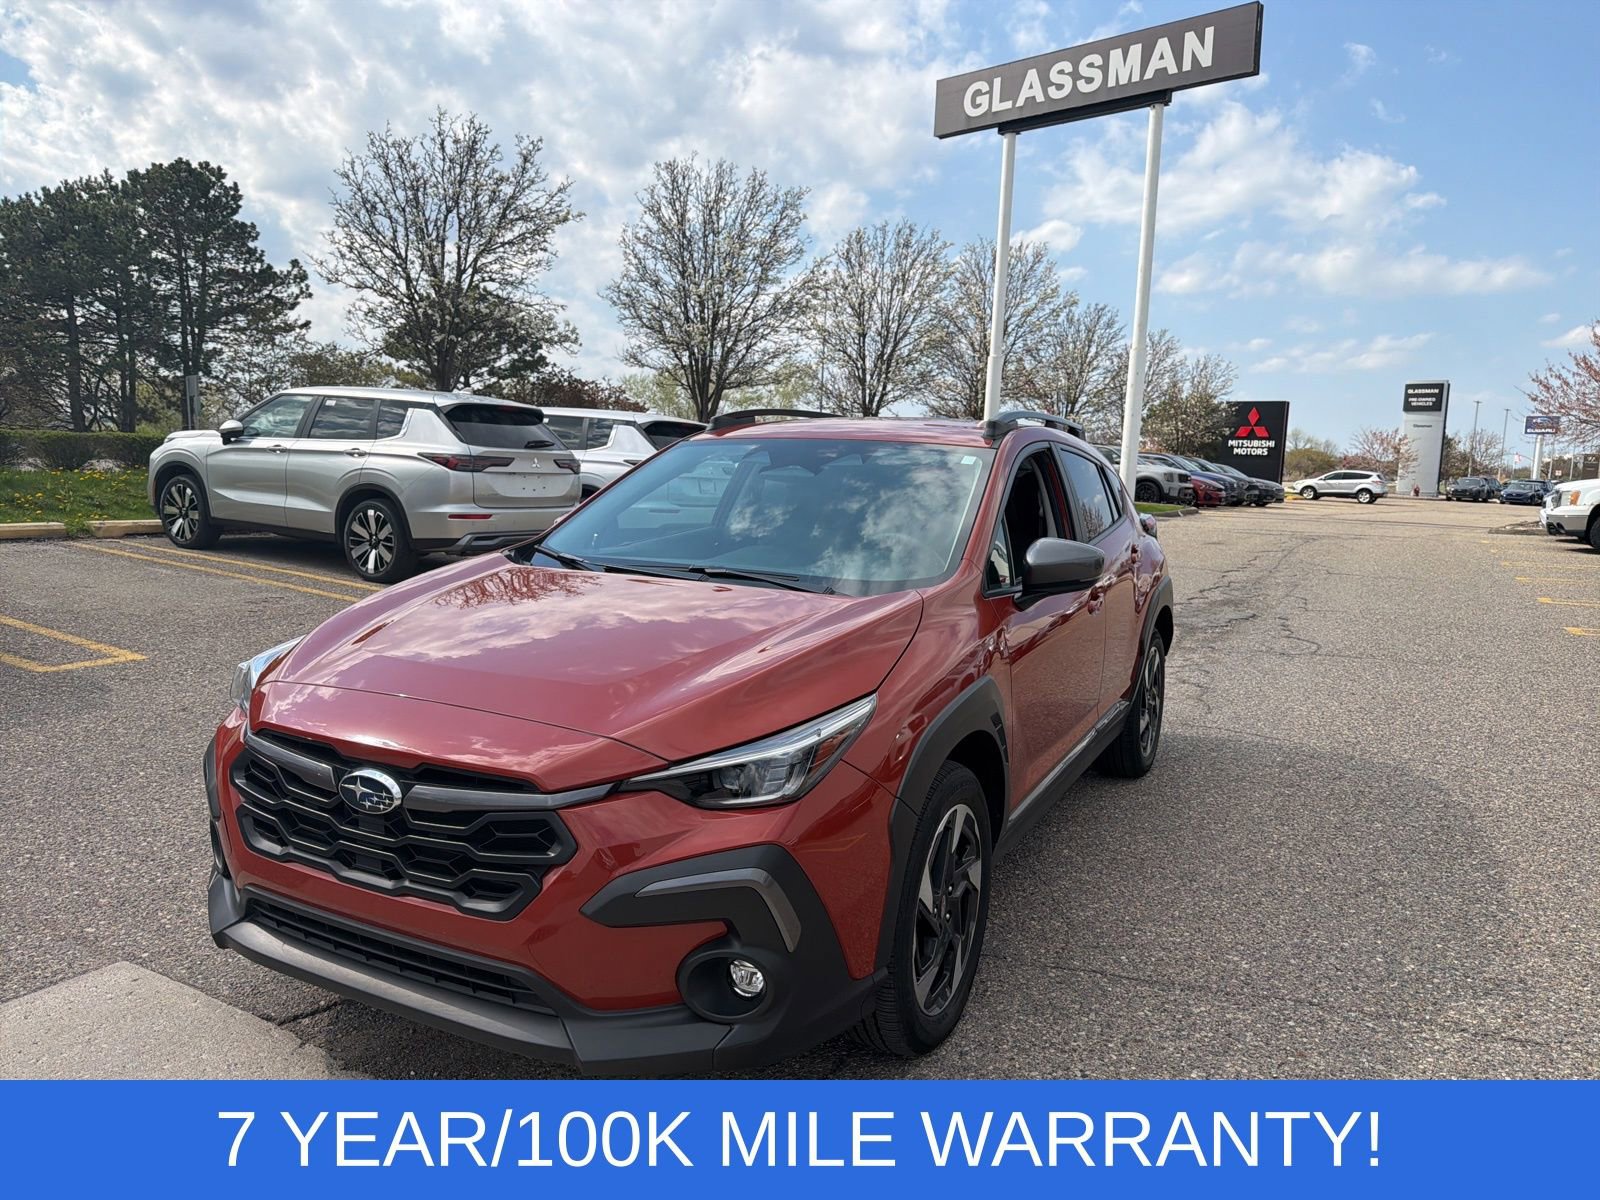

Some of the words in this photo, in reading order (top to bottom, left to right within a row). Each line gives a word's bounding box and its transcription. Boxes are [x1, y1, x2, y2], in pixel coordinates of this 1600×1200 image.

[963, 26, 1215, 118] GLASSMAN
[1228, 440, 1275, 448] MITSUBISHI
[1233, 448, 1268, 456] MOTORS
